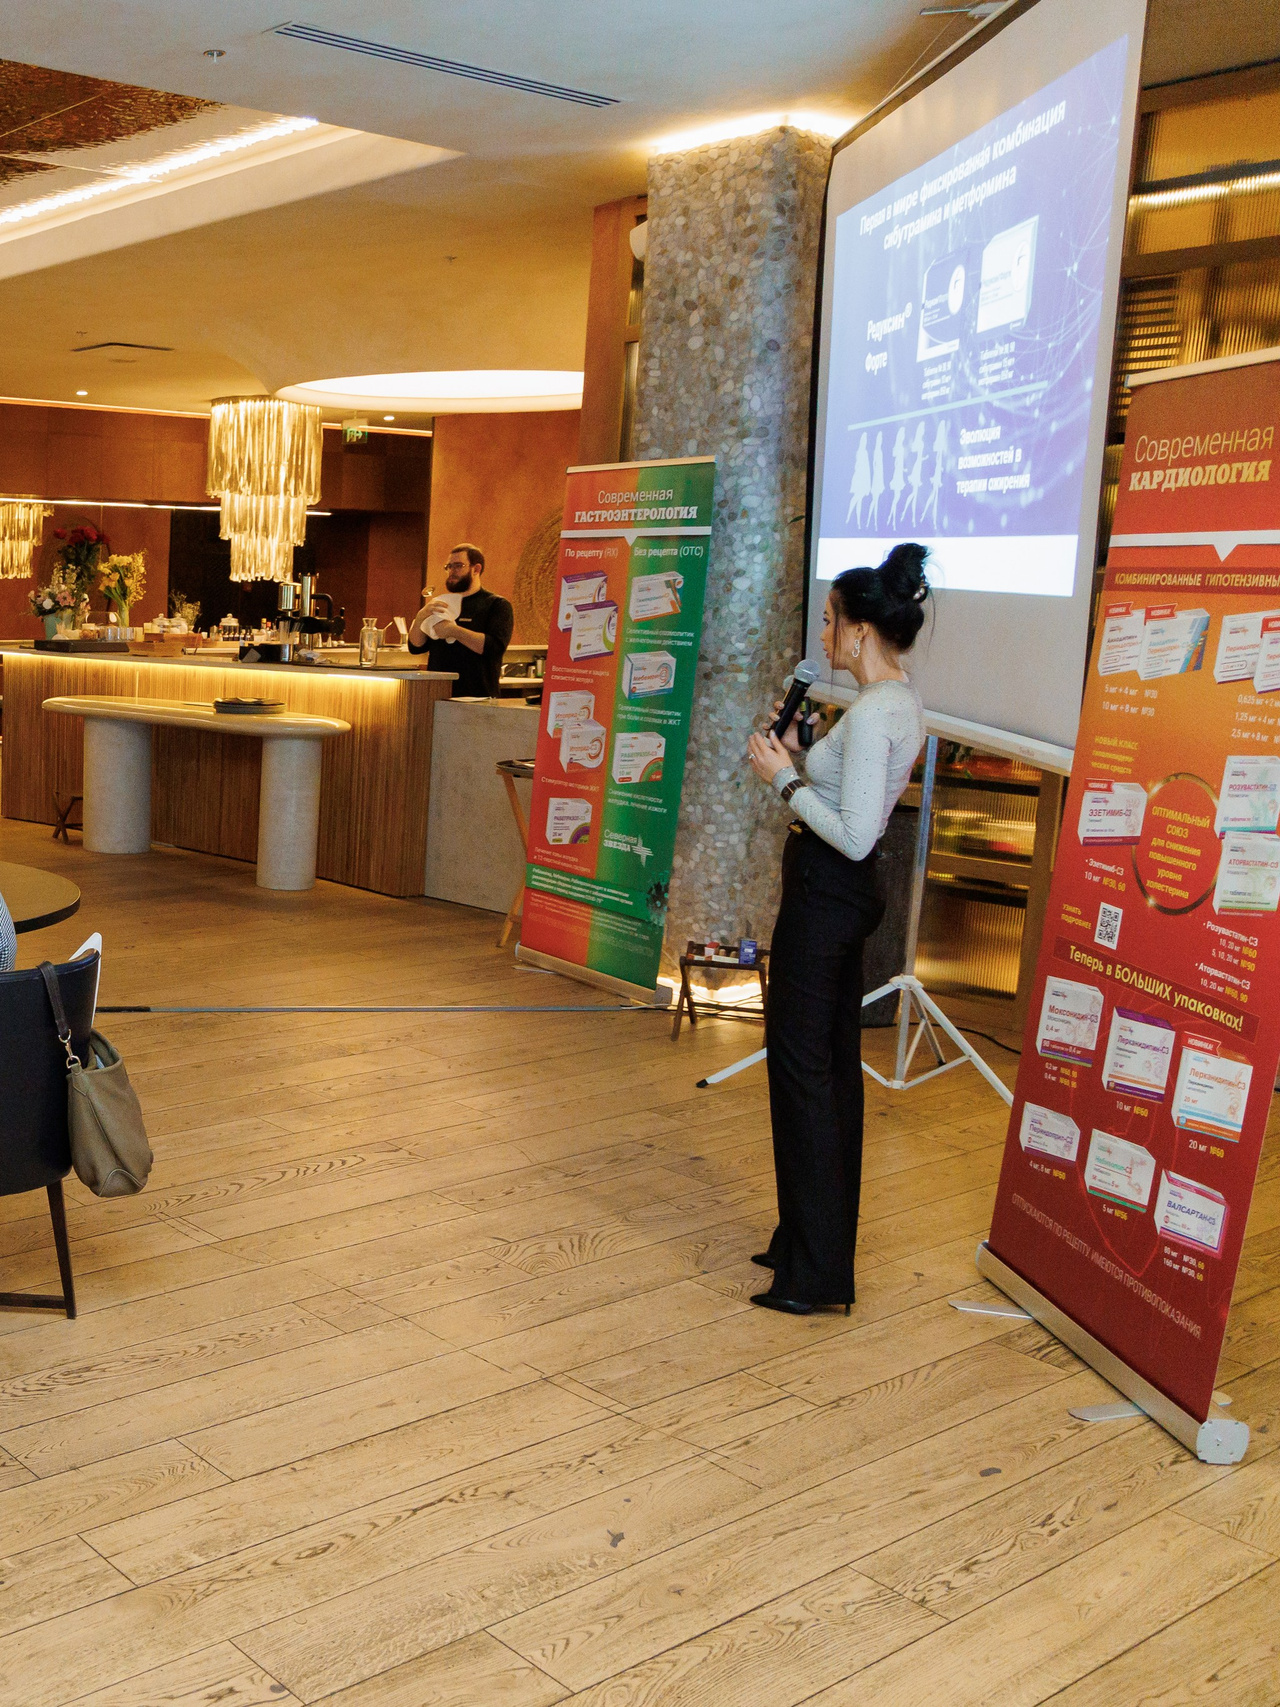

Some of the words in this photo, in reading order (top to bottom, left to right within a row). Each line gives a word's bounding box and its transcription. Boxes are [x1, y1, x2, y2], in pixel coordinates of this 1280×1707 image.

[860, 207, 886, 235] Первая
[893, 190, 918, 215] мире
[992, 100, 1066, 160] комбинация
[884, 208, 942, 250] сибутрамина
[951, 166, 1017, 215] метформина
[865, 352, 887, 376] Форте
[960, 426, 1001, 445] Эволюция
[1135, 427, 1274, 466] Современная
[958, 446, 1014, 470] возможностей
[1015, 448, 1022, 462] в
[1129, 459, 1272, 492] КАРДИОЛОГИЯ
[956, 478, 987, 497] терапии
[988, 474, 1031, 494] ожирения
[598, 489, 673, 506] Современная
[574, 506, 698, 523] ГАСТРОЭНТЕРОЛОГИЯ
[565, 549, 575, 557] По
[576, 549, 603, 559] рецепту
[634, 547, 646, 556] Без
[648, 548, 678, 558] рецепта
[1115, 573, 1202, 586] КОМБИНИРОВАННЫЕ
[667, 718, 682, 726] ЖКТ
[1235, 712, 1248, 721] 1,25
[1232, 728, 1241, 738] 2,5
[1095, 735, 1118, 747] НОВЫЙ
[1119, 739, 1138, 750] КЛАСС
[1152, 806, 1210, 828] ОПТИМАЛЬНЫЙ
[604, 829, 637, 844] Северная
[1166, 824, 1189, 838] СОЮЗ
[603, 839, 631, 852] ЗВЕЗДА
[1151, 838, 1165, 847] для
[1166, 841, 1201, 857] снижения
[1149, 851, 1197, 871] повышенного
[1228, 859, 1279, 868] АТОРВАСТАТИН-СЗ
[1085, 871, 1092, 880] 10
[1157, 868, 1182, 882] уровня
[1146, 880, 1189, 899] холестерина
[1063, 904, 1081, 915] УЗНАТЬ
[1061, 913, 1091, 929] ПОДРОБНЕЕ
[1206, 921, 1258, 947] Розувастатин-СЗ
[1228, 941, 1234, 950] 20
[1198, 962, 1250, 990] Аторвастатин-СЗ
[1070, 945, 1103, 973] Теперь
[1106, 968, 1112, 976] в
[1115, 964, 1172, 1001] БОЛЬШИХ
[1172, 991, 1243, 1032] упаковках!
[1209, 981, 1217, 990] 20
[1048, 1004, 1098, 1023] Моксонидин-СЗ
[1187, 1038, 1214, 1050] НОВИНКА!
[1190, 1067, 1246, 1091] Лерканидипин-СЗ
[1116, 1101, 1124, 1110] 10
[1124, 1104, 1132, 1112] мг
[1189, 1139, 1198, 1149] 20
[1198, 1144, 1207, 1152] мг
[1166, 1200, 1216, 1226] ВАЛСАРТАН-СЗ
[1012, 1193, 1053, 1231] ОТПУСКАЮТСЯ
[1053, 1222, 1062, 1236] ПО
[1091, 1251, 1124, 1282] ИМЕЮТСЯ
[1124, 1273, 1201, 1339] ПРОТИВОПОКАЗАНИЯ
